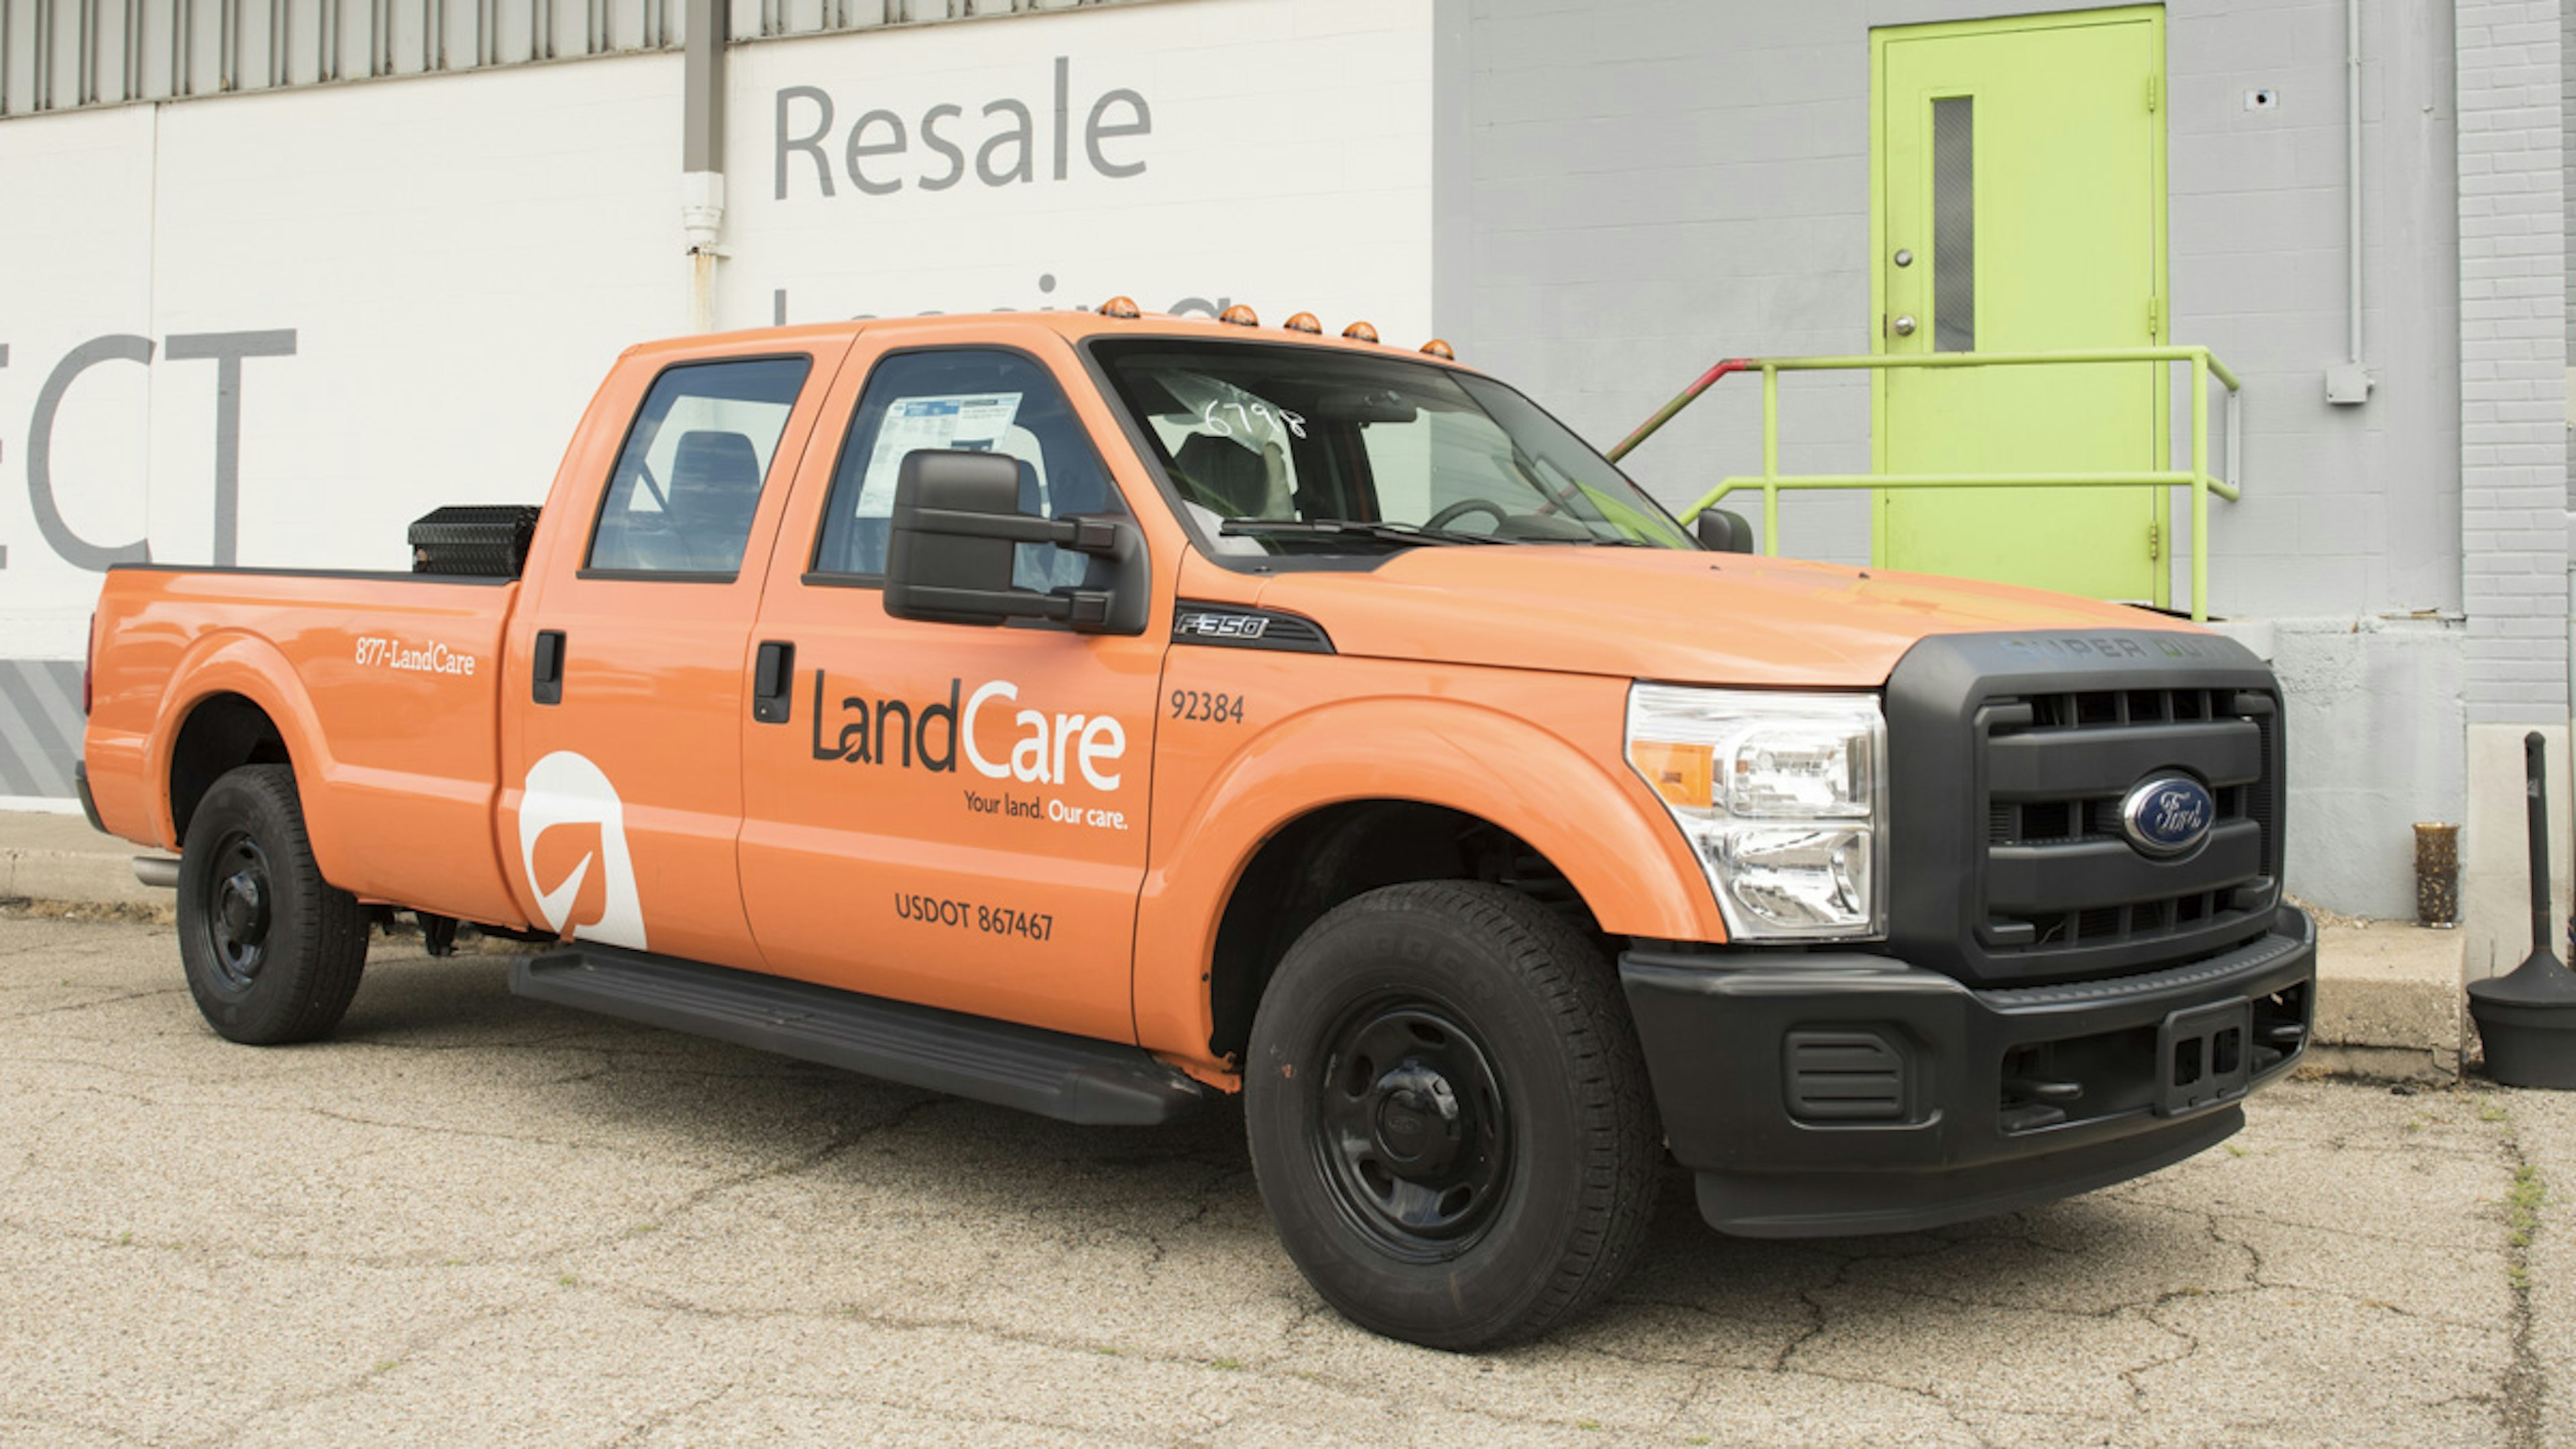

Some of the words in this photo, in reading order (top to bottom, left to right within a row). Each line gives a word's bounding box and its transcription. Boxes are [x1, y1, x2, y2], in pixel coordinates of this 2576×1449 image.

[775, 56, 1152, 201] Resale
[1204, 398, 1307, 439] 6798
[0, 328, 297, 573] CT
[356, 637, 475, 676] 877-LandCare
[1171, 690, 1244, 724] 92384
[812, 669, 1126, 791] LandCare
[963, 790, 1000, 814] Your
[1004, 792, 1045, 819] land.
[1048, 798, 1083, 824] Our
[1085, 808, 1128, 830] care.
[2155, 790, 2202, 834] Ford
[895, 892, 971, 928] USDOT
[977, 905, 1053, 941] 867467
